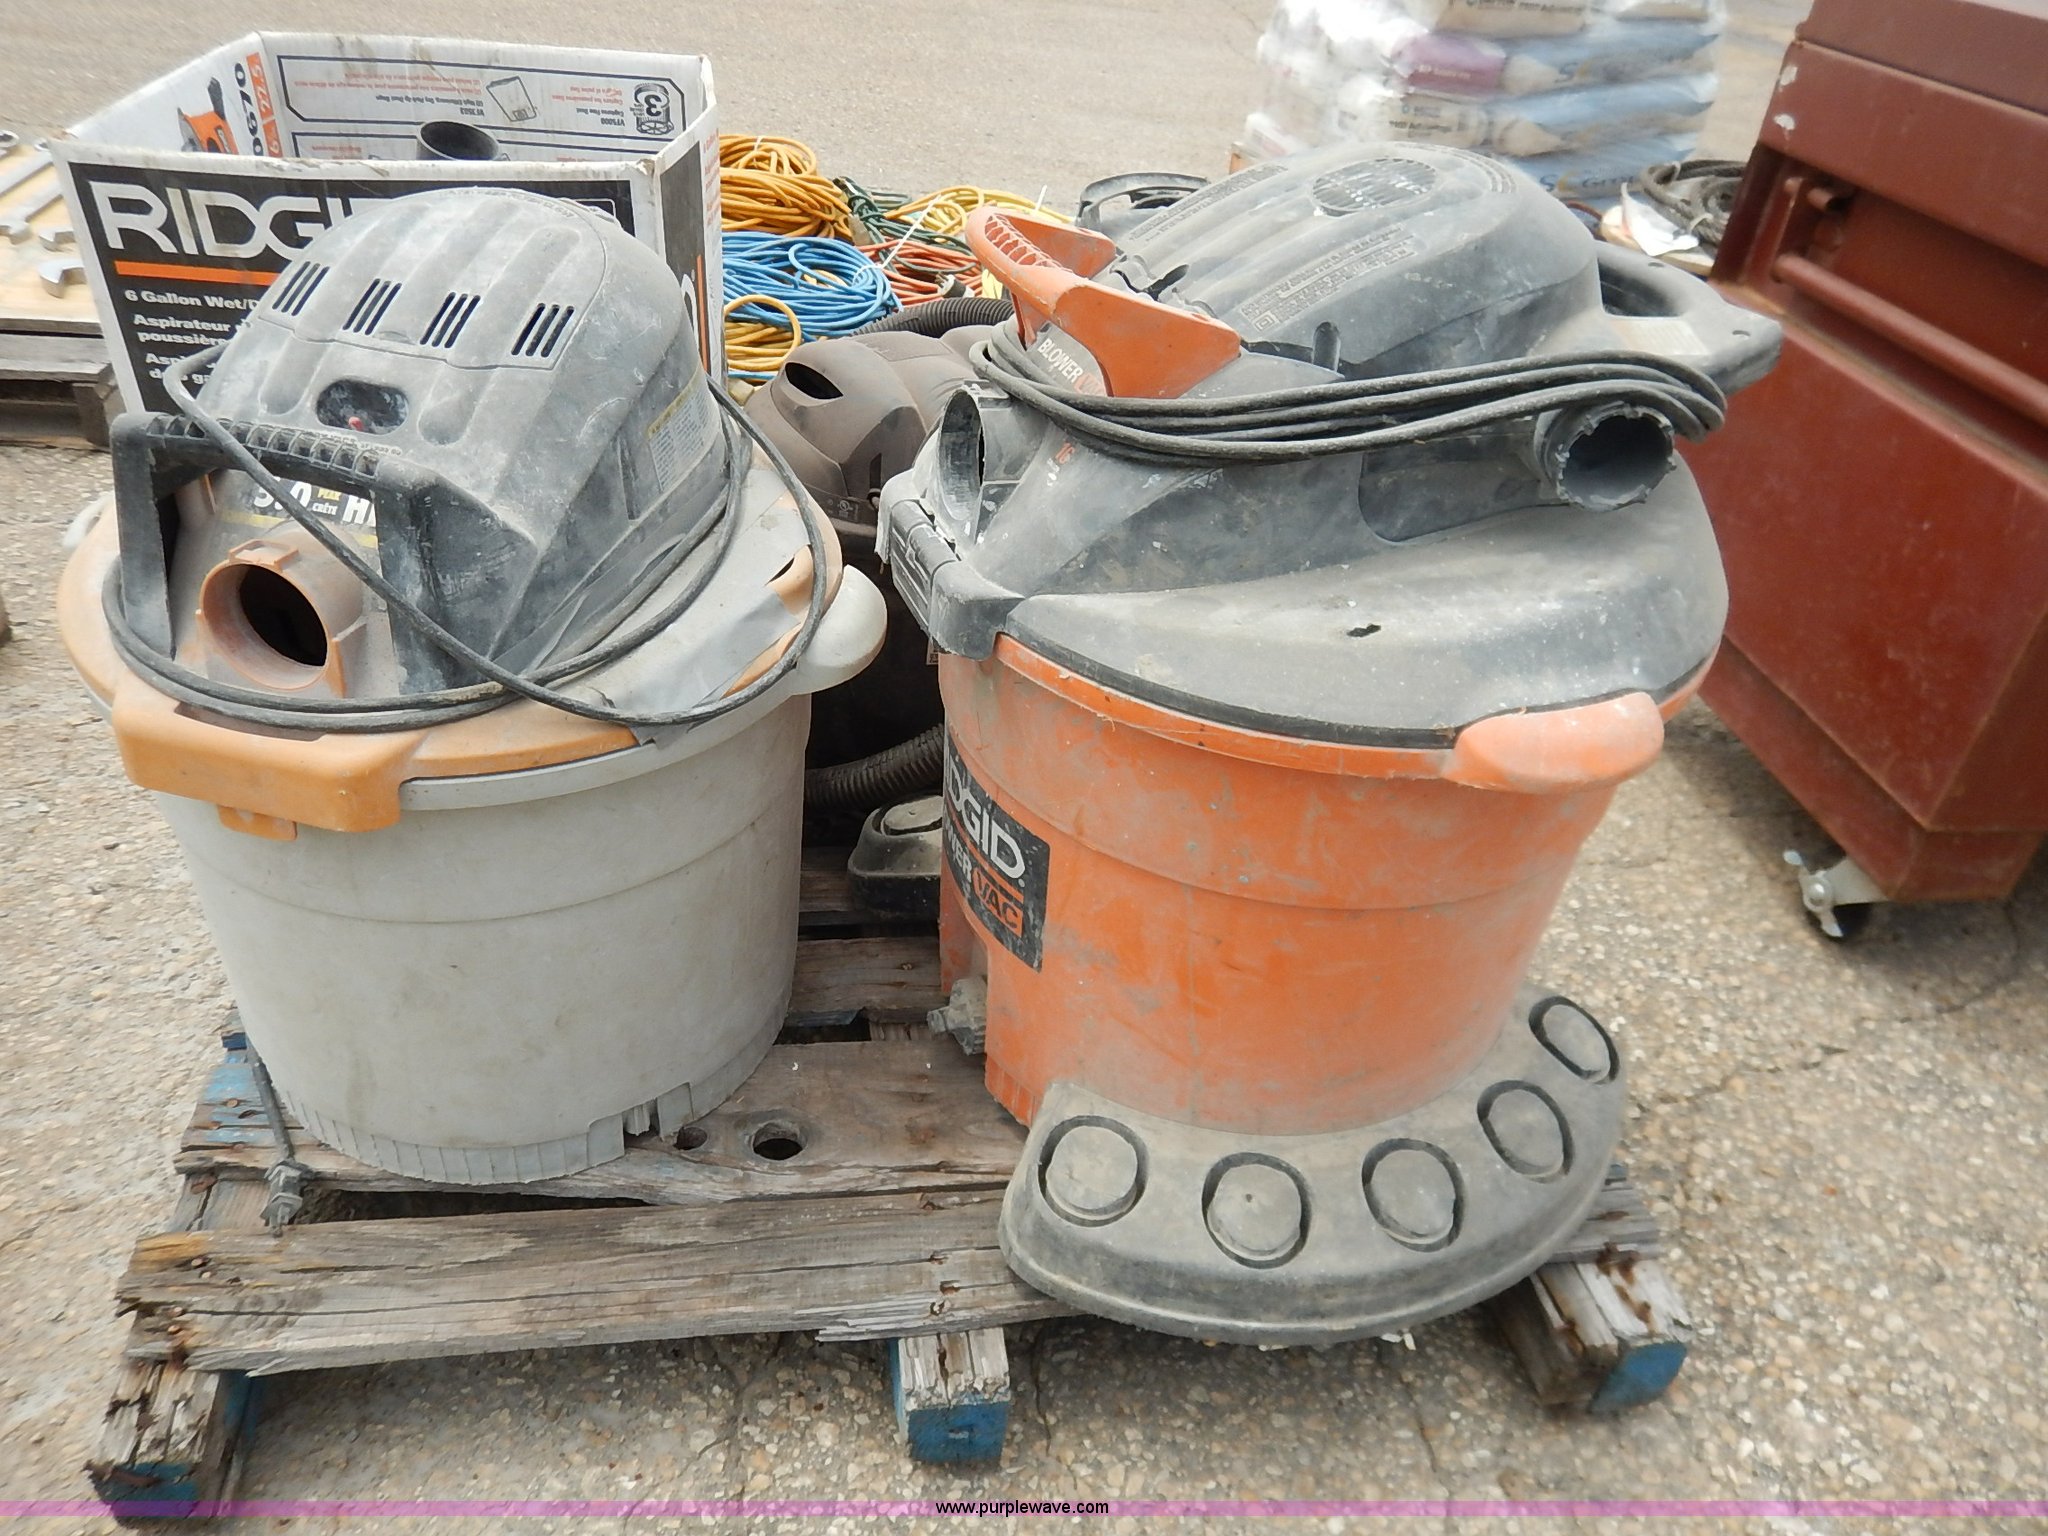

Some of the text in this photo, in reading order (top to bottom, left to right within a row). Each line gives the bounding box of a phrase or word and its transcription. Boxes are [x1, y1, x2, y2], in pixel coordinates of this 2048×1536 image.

[644, 94, 662, 117] 3
[88, 181, 372, 262] RIDG
[124, 289, 260, 310] 6 Gallon Wet/D
[133, 314, 231, 332] Aspirateur
[1037, 338, 1083, 383] BLOWER
[975, 869, 1018, 929] VAC
